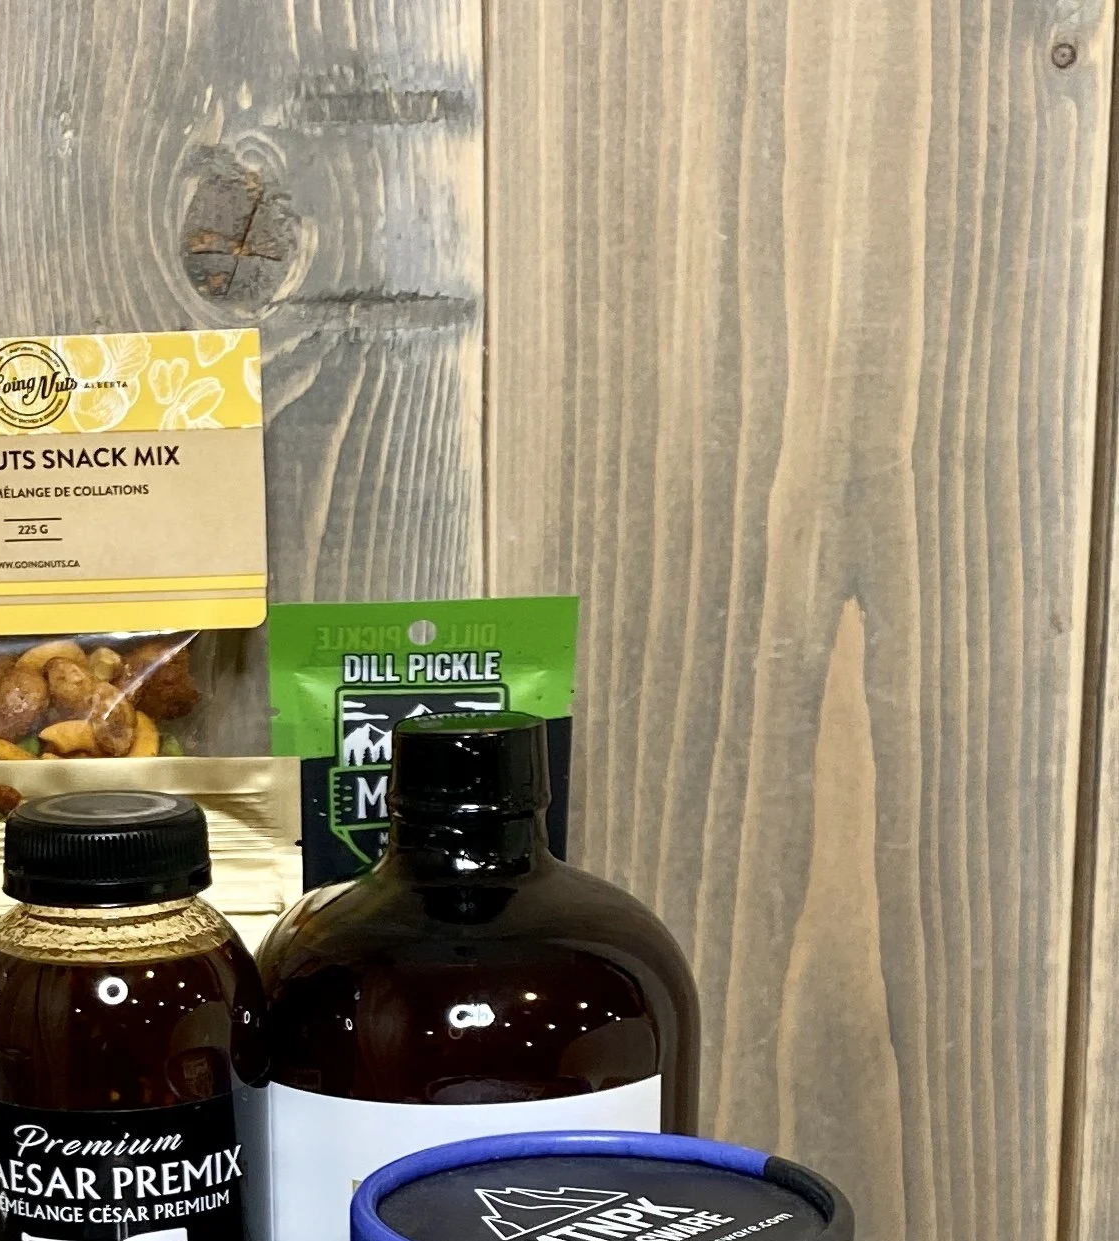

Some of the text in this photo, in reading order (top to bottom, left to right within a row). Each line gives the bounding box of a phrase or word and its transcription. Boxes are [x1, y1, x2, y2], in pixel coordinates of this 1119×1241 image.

[22, 371, 77, 406] Nuts
[83, 380, 129, 389] ALBERTA
[41, 447, 128, 469] SNACK
[133, 445, 180, 467] MIX
[54, 486, 71, 497] DE
[73, 484, 149, 497] COLLATIONS
[18, 524, 49, 535] 225 G
[343, 652, 501, 683] DILL PICKLE
[13, 1124, 183, 1157] Premium
[112, 1144, 243, 1200] PREMIX
[88, 1205, 150, 1223] CÉSAR
[154, 1189, 230, 1219] PREMIUM
